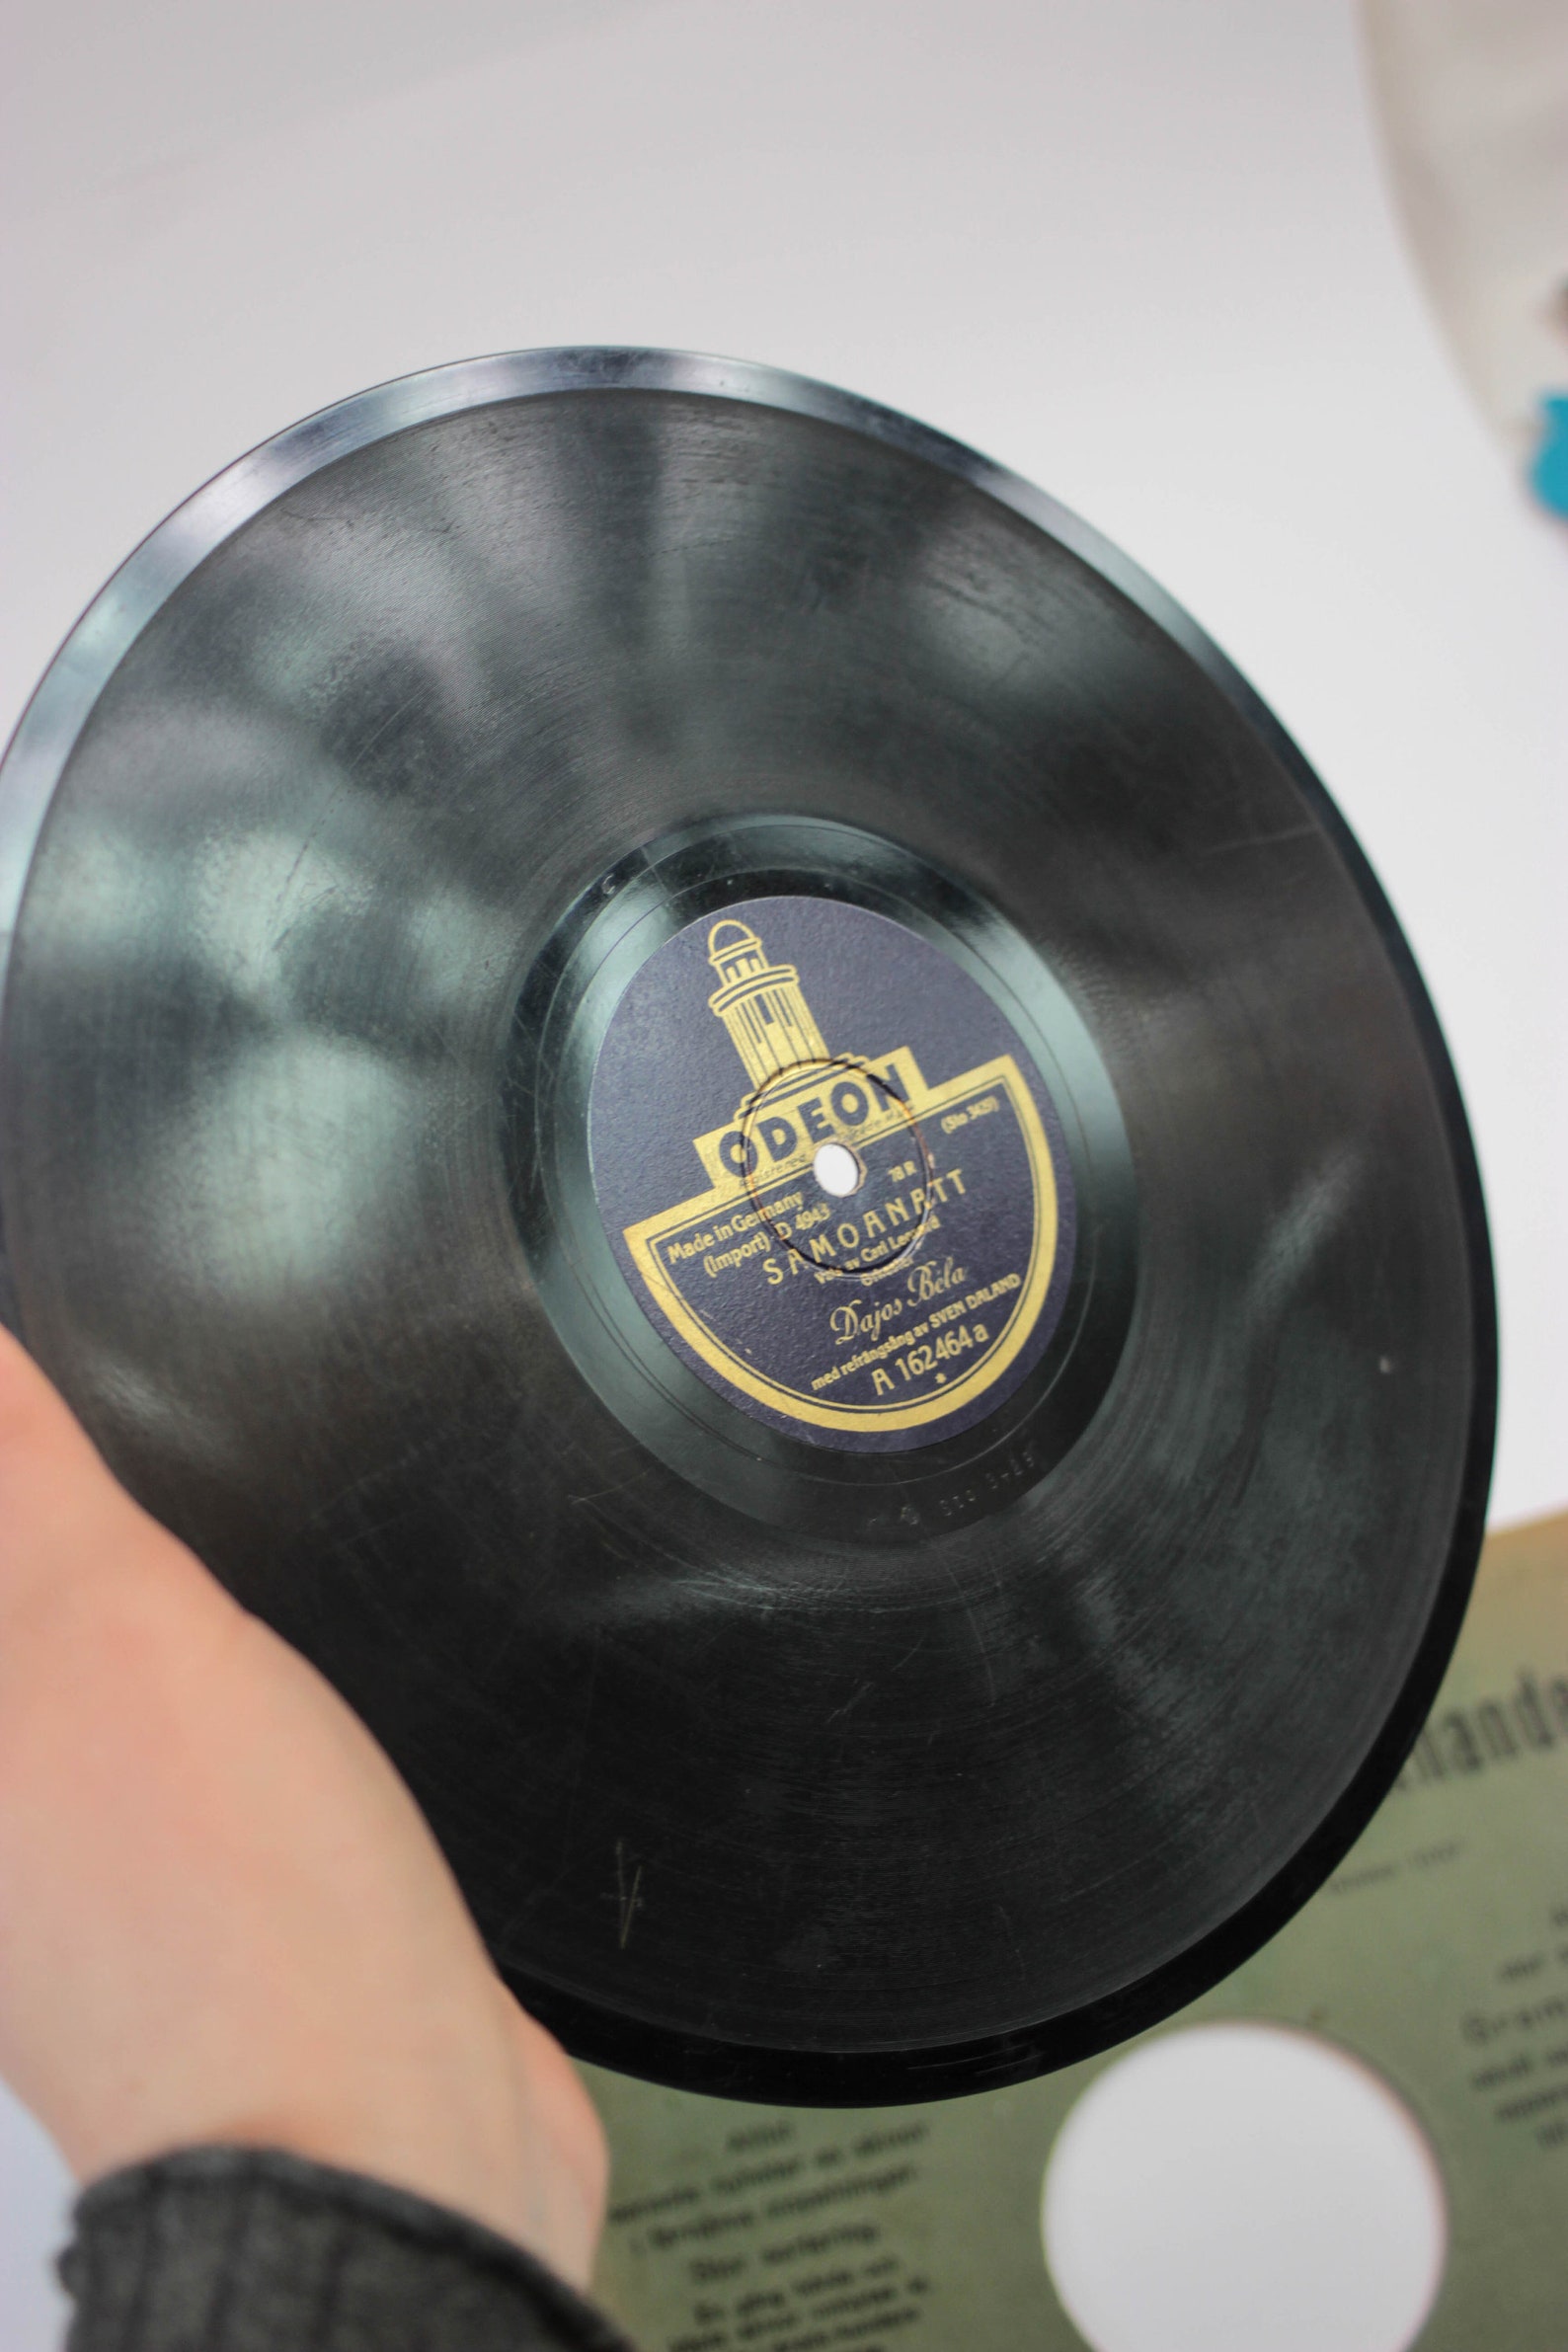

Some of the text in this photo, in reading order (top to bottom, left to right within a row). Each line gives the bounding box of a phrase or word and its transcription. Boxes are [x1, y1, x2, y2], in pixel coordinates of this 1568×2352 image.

[719, 1064, 909, 1177] ODEON
[666, 1192, 804, 1264] Made in Germany
[703, 1231, 771, 1278] (Import)
[774, 1221, 792, 1241] D
[811, 1365, 840, 1391] med
[912, 1320, 930, 1338] av
[929, 1299, 967, 1329] SVEN
[829, 1298, 903, 1345] Dajos
[871, 1323, 989, 1396] A 162464 a
